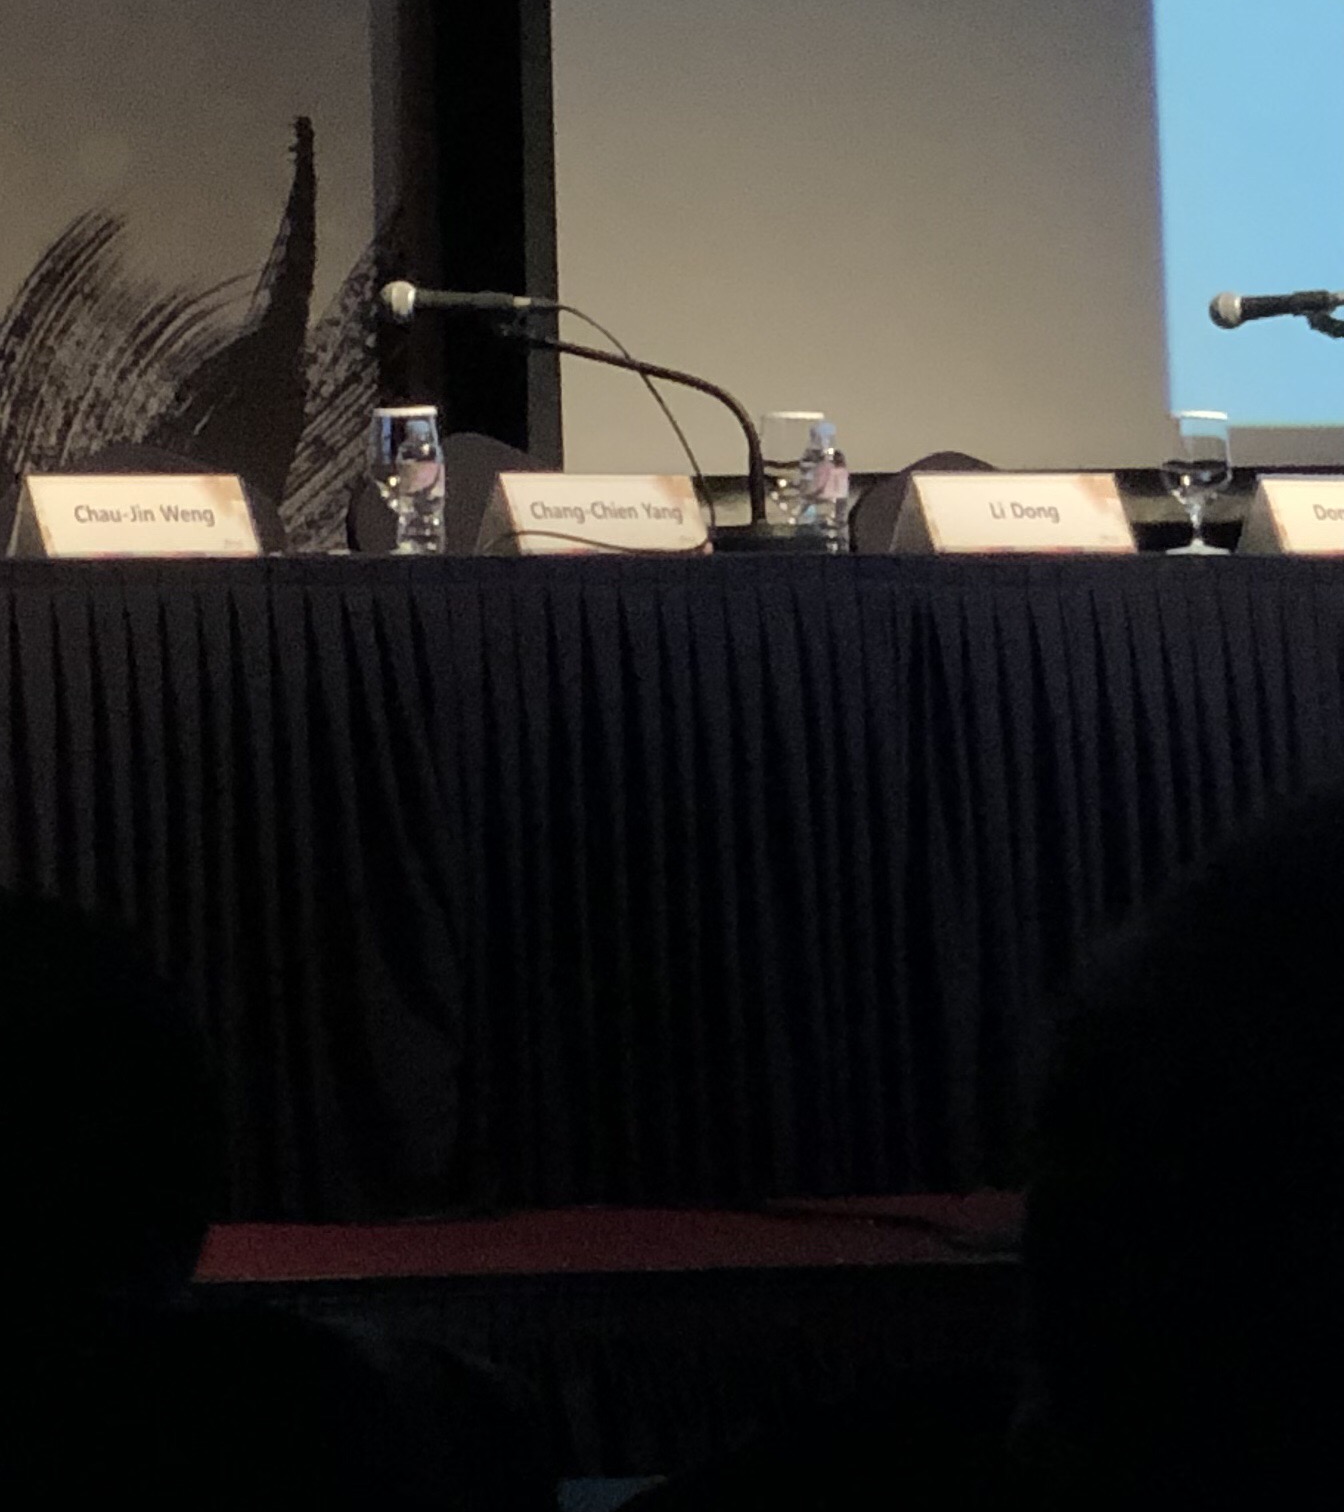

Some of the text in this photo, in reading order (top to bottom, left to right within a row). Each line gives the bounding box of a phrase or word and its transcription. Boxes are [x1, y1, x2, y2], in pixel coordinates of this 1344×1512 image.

[73, 504, 216, 528] Chau-Jin Weng
[529, 501, 684, 525] Chang-Chien Yang
[1011, 502, 1061, 524] Dong
